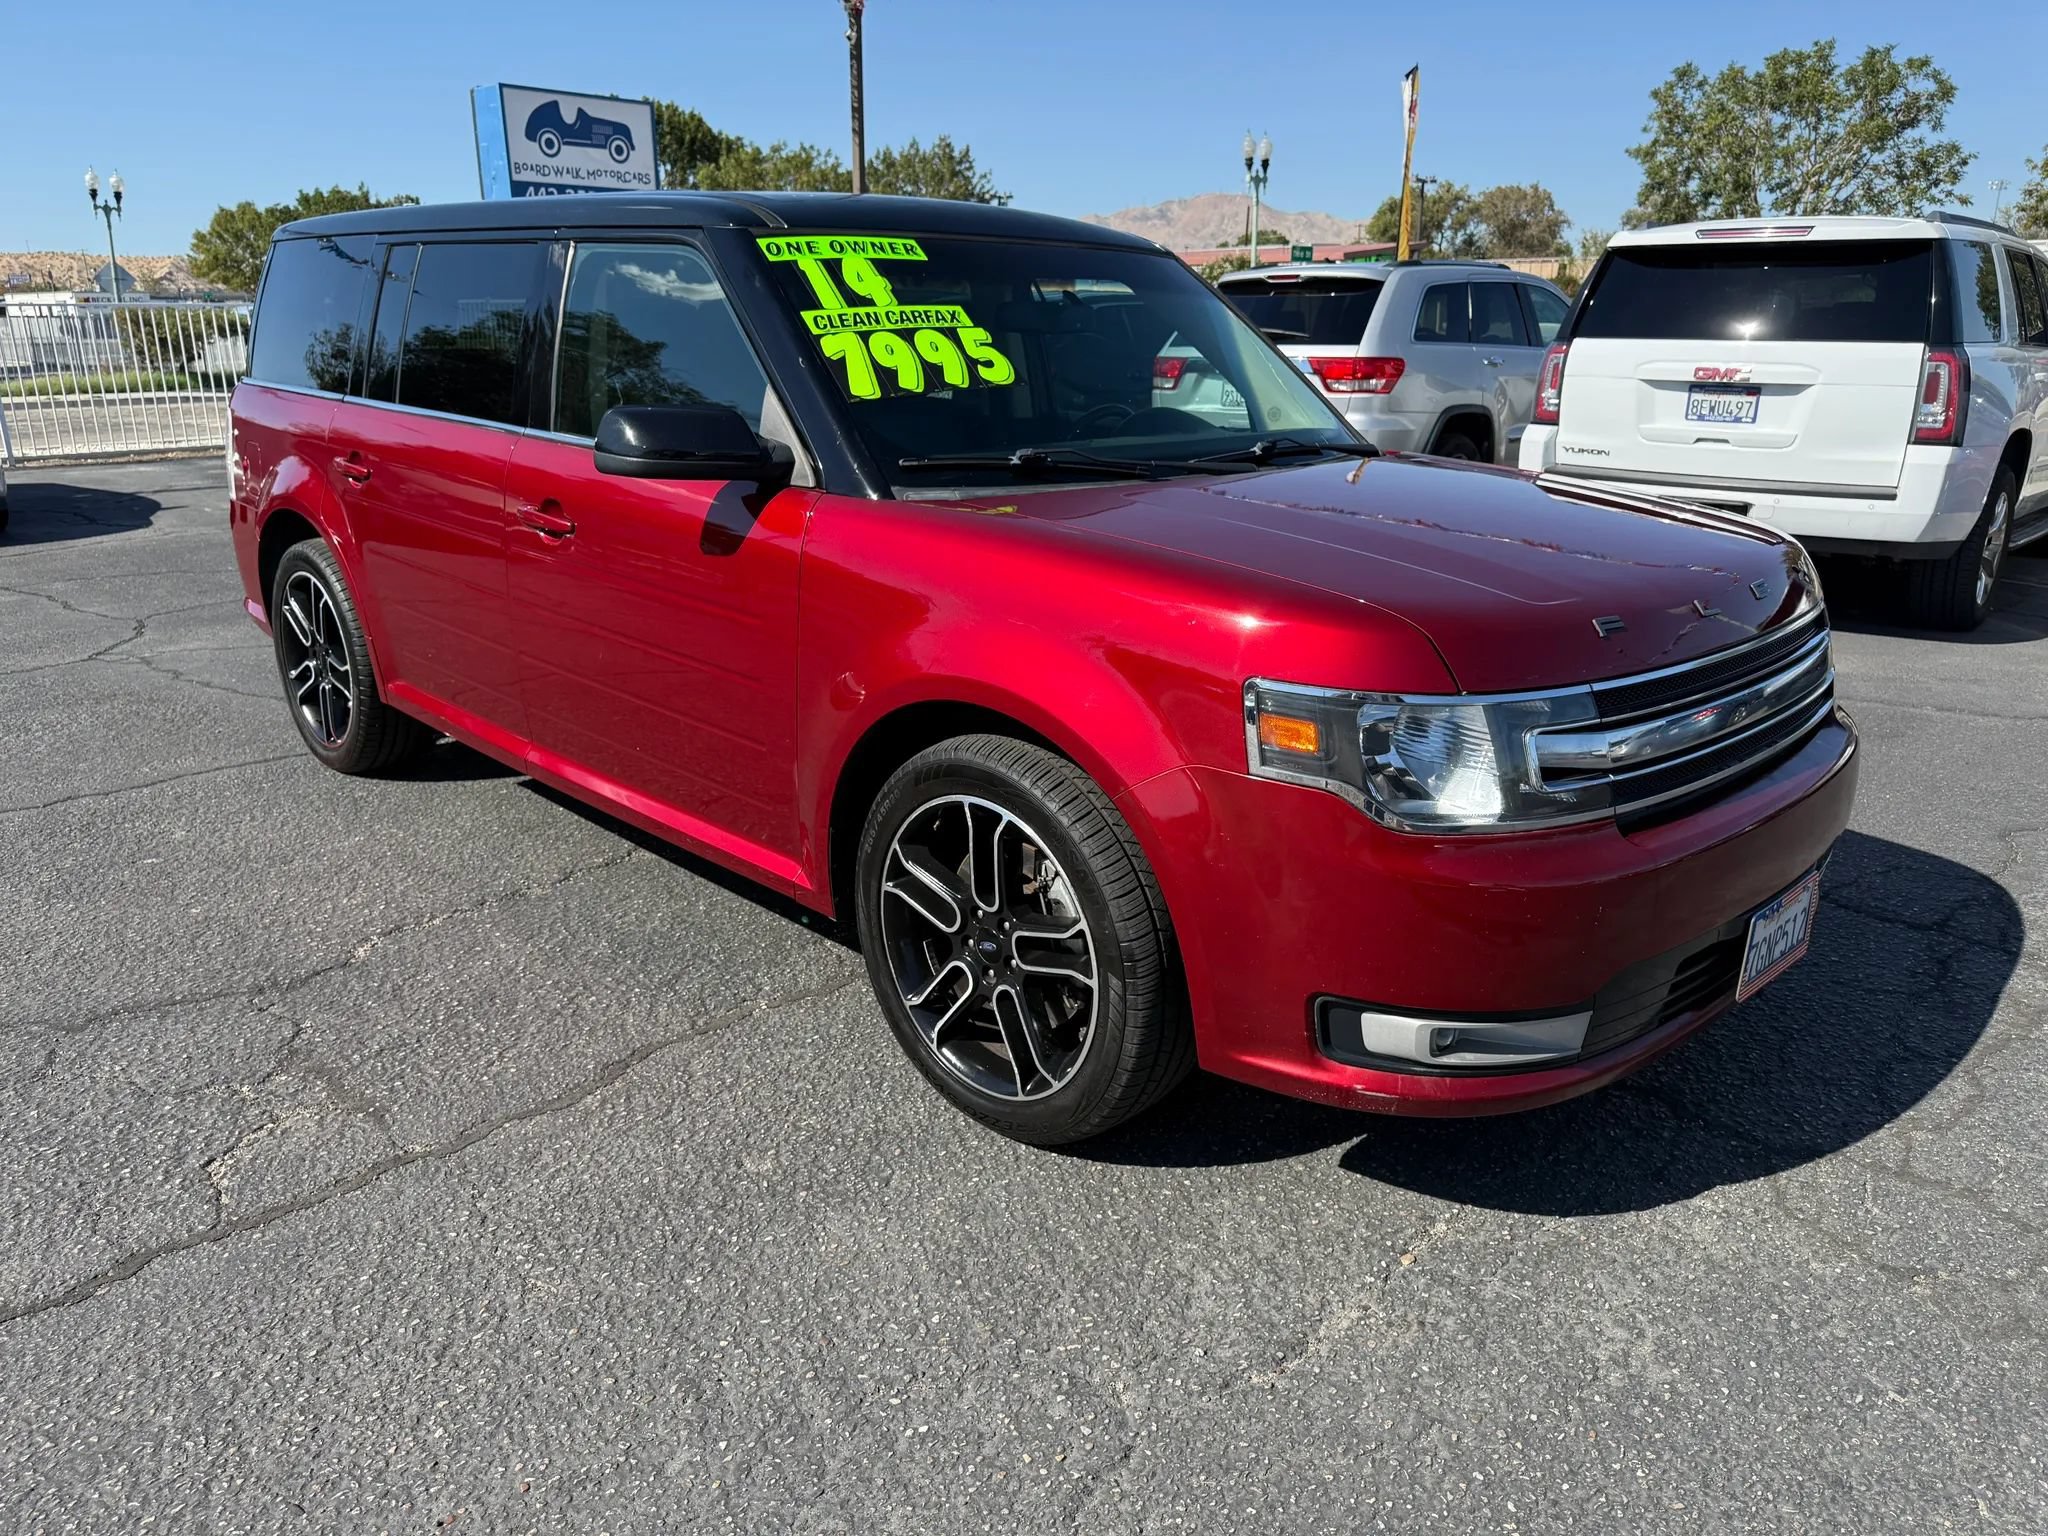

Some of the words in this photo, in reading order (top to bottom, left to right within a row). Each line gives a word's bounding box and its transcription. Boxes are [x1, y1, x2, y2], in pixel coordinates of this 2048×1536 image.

[514, 162, 585, 181] BOARDWALK
[587, 169, 651, 185] MOTORCARS
[765, 240, 820, 257] ONE
[829, 239, 922, 257] OWNER
[797, 257, 898, 310] 14
[813, 310, 882, 331] CLEAN
[885, 309, 962, 326] CARFAX
[819, 327, 1015, 400] 7995
[1693, 367, 1752, 382] GMC
[1690, 399, 1753, 419] 8EWU497
[1562, 446, 1610, 457] YUKON
